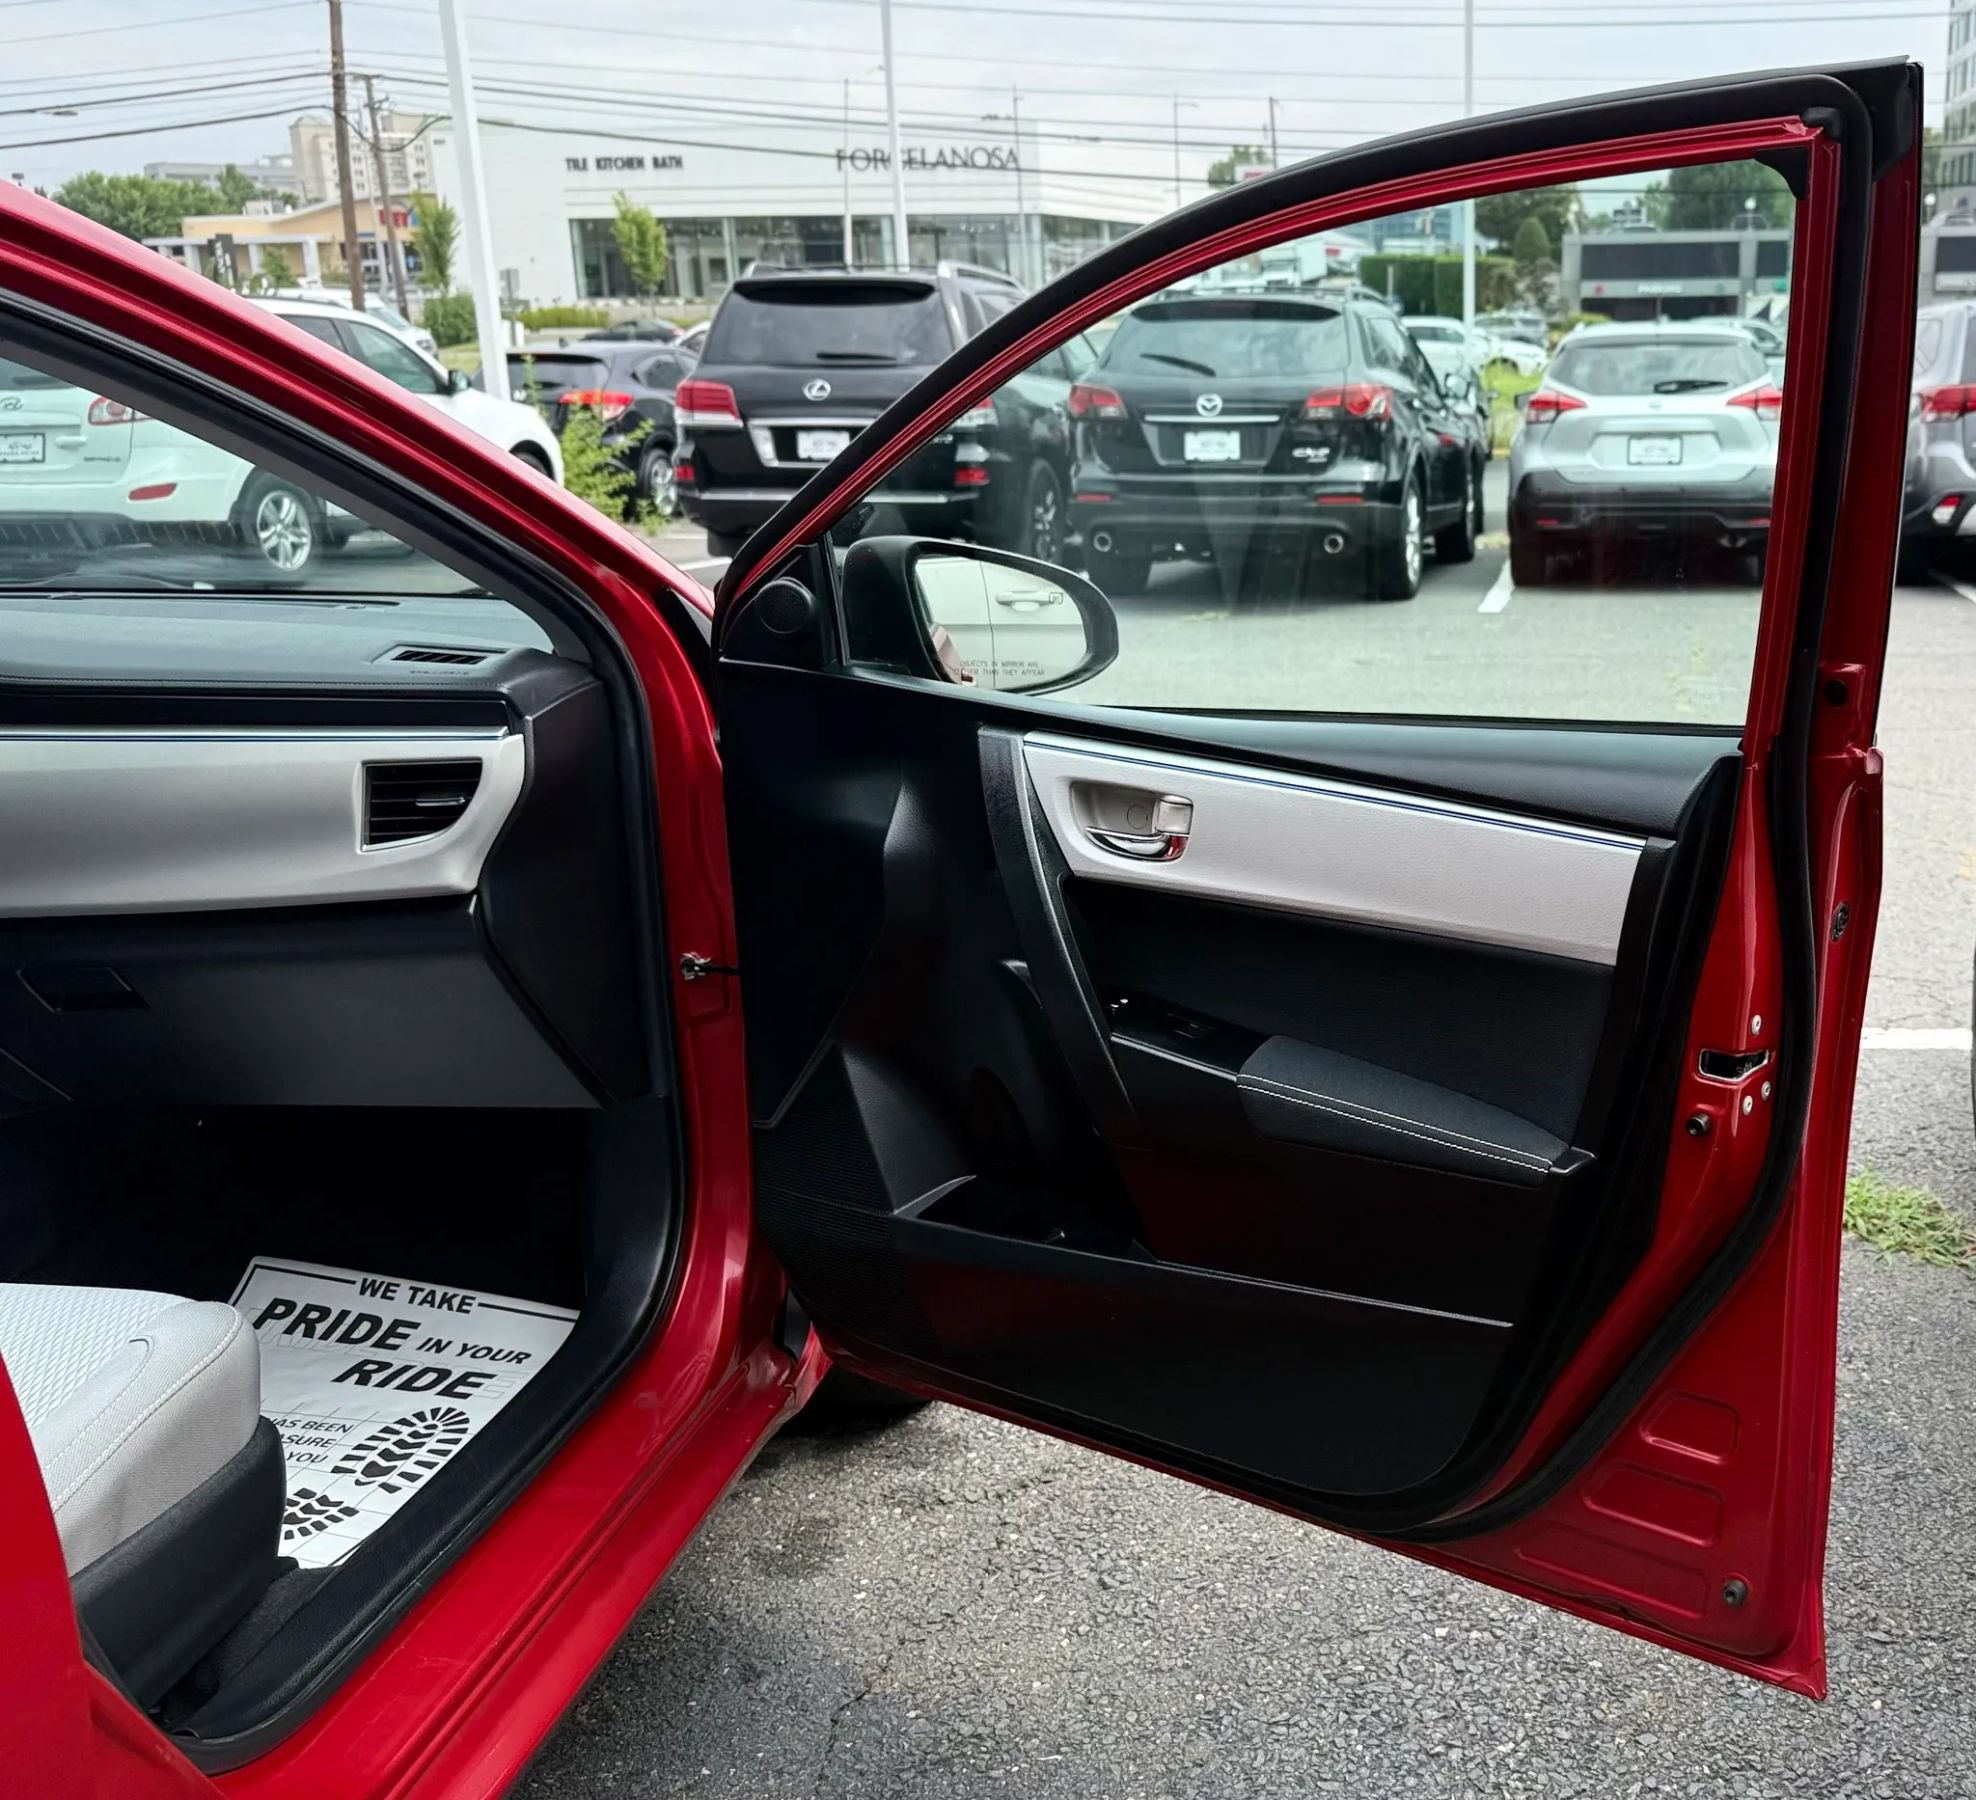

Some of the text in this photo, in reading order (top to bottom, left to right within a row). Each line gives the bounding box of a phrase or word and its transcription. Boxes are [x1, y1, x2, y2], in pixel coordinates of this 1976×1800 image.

[953, 668, 979, 676] CSER
[358, 1277, 477, 1315] WE TAKE
[252, 1297, 532, 1365] PRIDE IN YOUR
[330, 1358, 498, 1400] RIDE
[300, 1420, 354, 1434] BEEN
[286, 1451, 329, 1463] YOU
